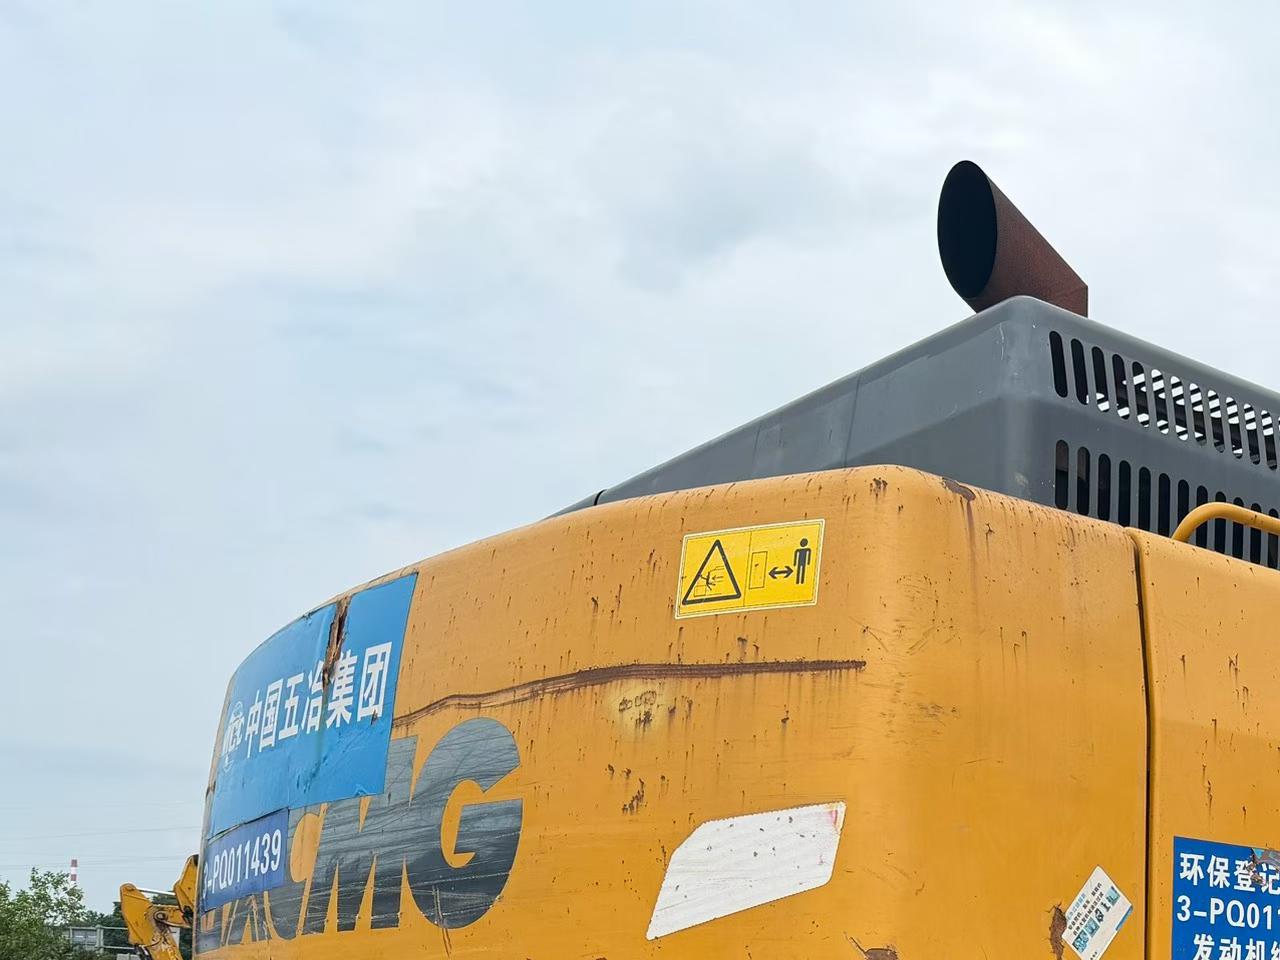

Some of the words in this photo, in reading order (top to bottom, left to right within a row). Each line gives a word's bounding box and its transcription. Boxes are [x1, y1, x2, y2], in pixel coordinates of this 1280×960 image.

[244, 641, 393, 759] 中国五冶集团
